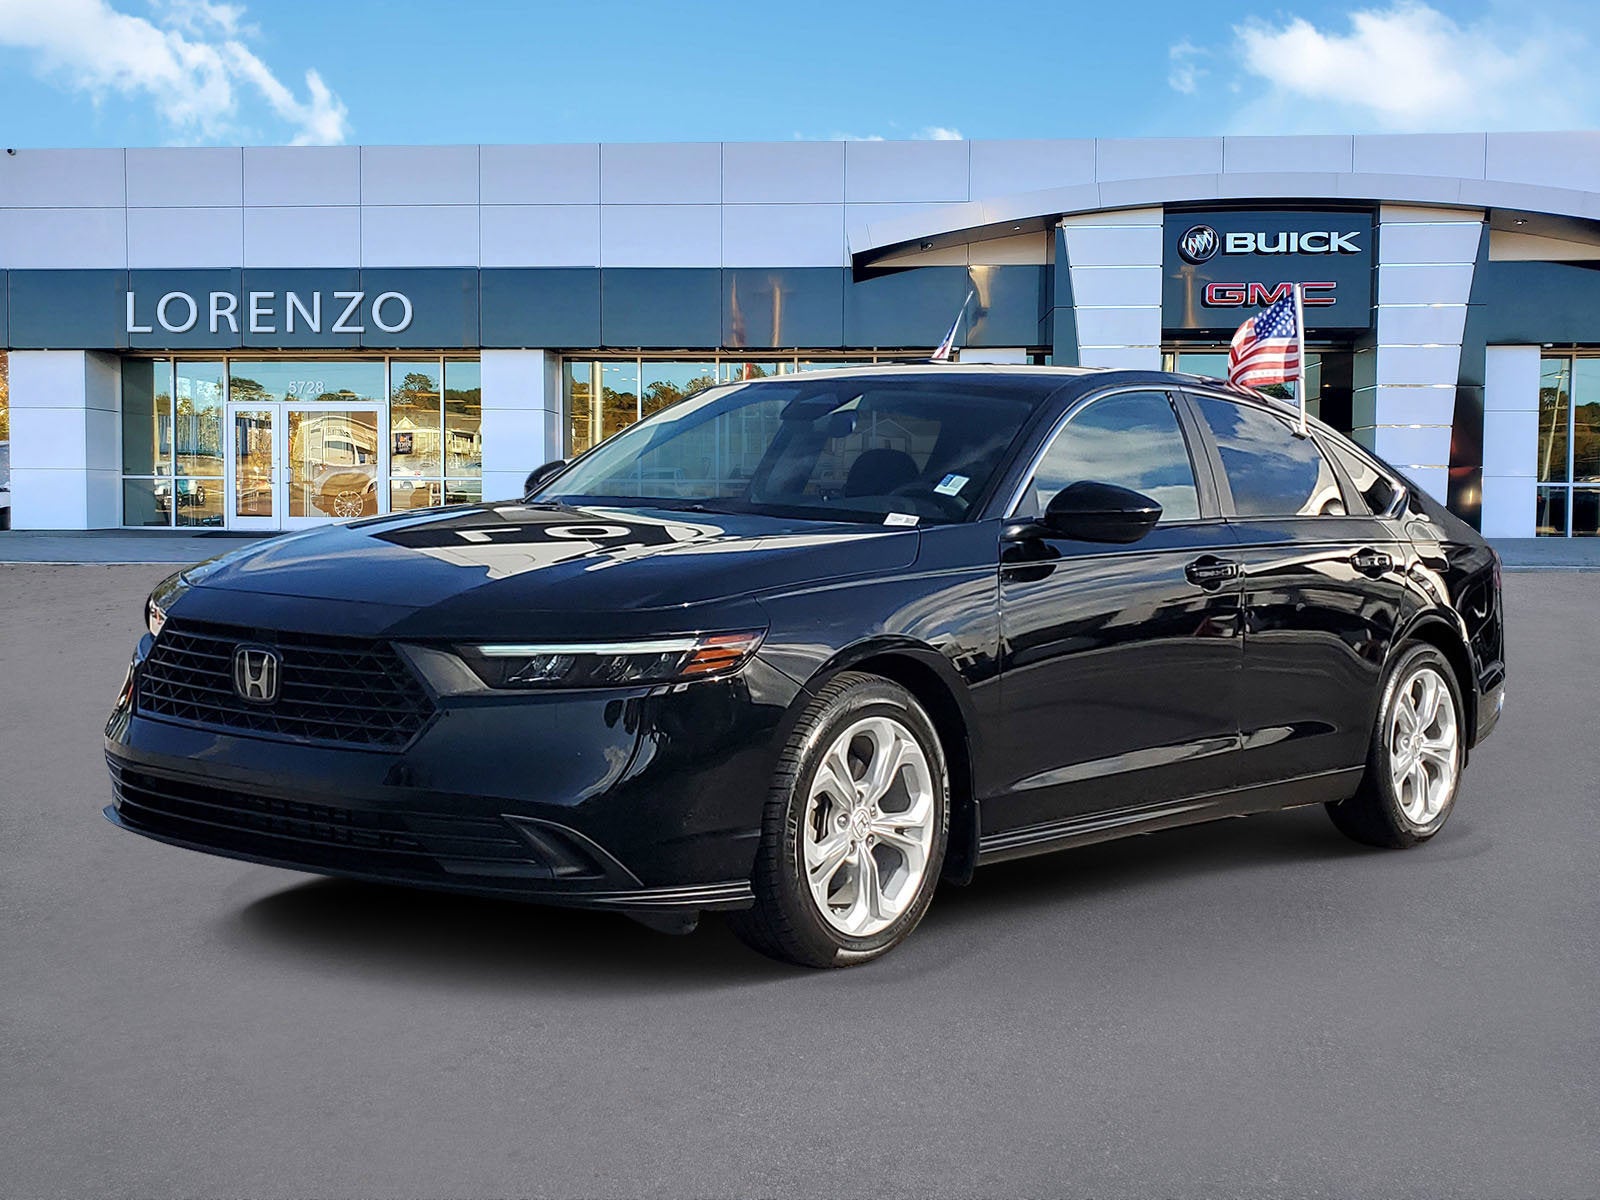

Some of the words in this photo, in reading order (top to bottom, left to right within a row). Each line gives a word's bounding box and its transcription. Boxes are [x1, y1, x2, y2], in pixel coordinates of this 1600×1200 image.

[1225, 231, 1362, 253] BUICK
[1206, 281, 1337, 305] GMC
[126, 290, 413, 334] LORENZO
[288, 380, 325, 394] 5728
